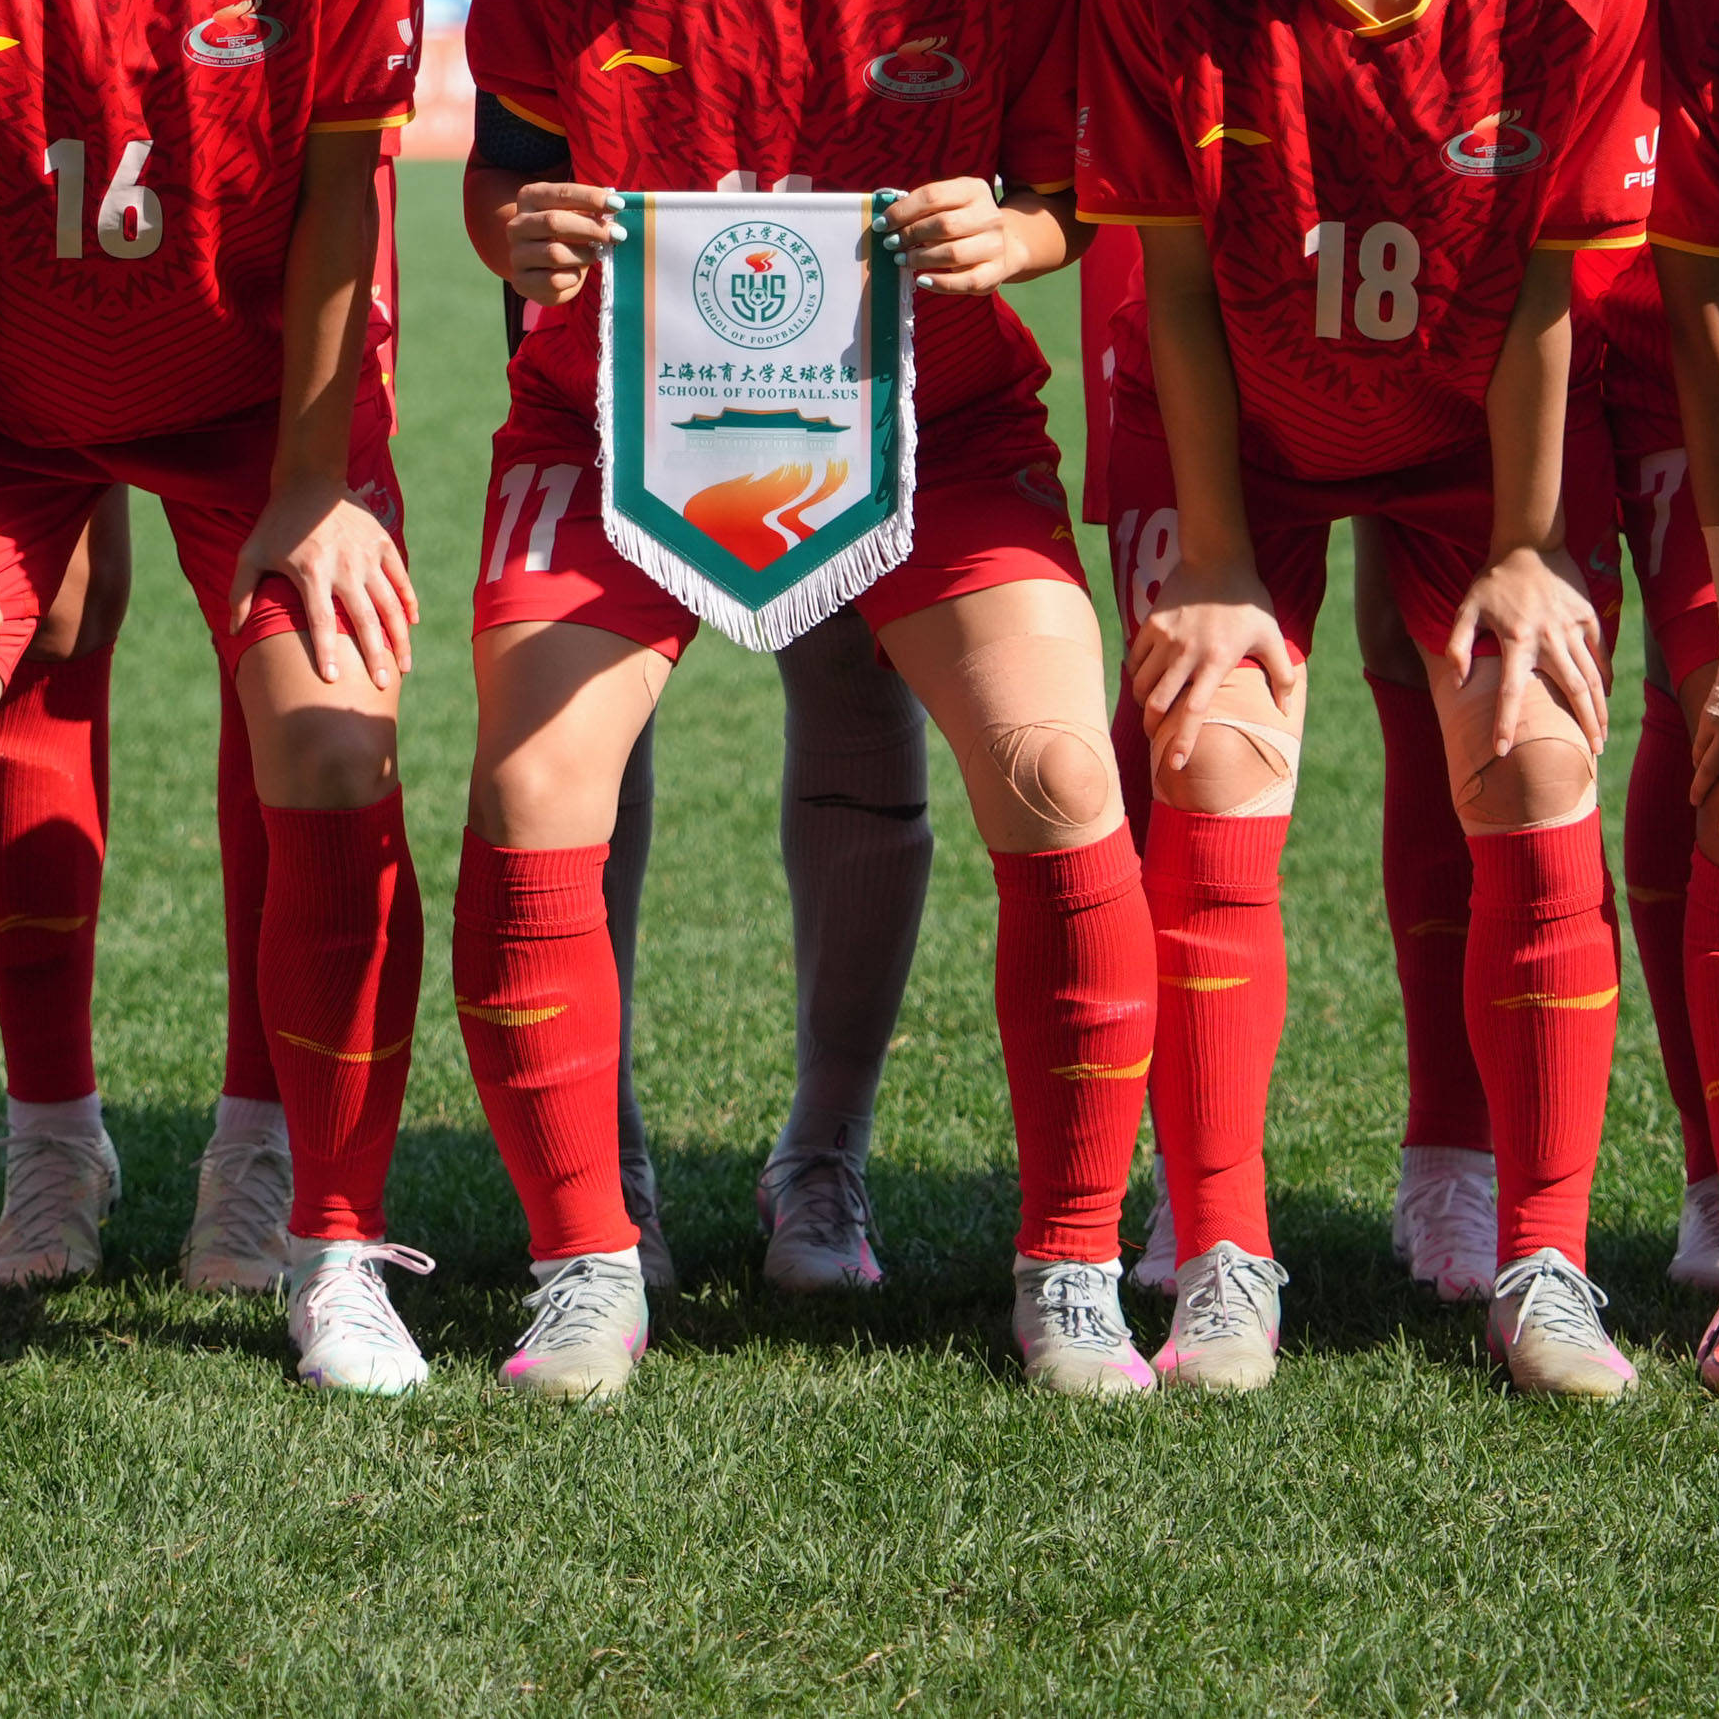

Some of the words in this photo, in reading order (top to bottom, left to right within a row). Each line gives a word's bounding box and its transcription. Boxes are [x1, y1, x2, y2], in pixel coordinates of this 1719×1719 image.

[44, 138, 162, 259] 16
[698, 225, 819, 284] 上海体育大学足球学院
[700, 290, 729, 334] SCHOOL
[730, 329, 747, 342] OF
[749, 293, 818, 345] FOOTBALL.SUS
[1305, 221, 1421, 341] 18
[658, 362, 860, 384] 上海体育大学足球学院
[658, 385, 718, 398] SCHOOL
[723, 387, 743, 399] OF
[748, 387, 860, 401] FOOTBALL.SUS
[486, 463, 583, 585] 11
[1640, 447, 1688, 578] 7
[1116, 507, 1181, 641] 18
